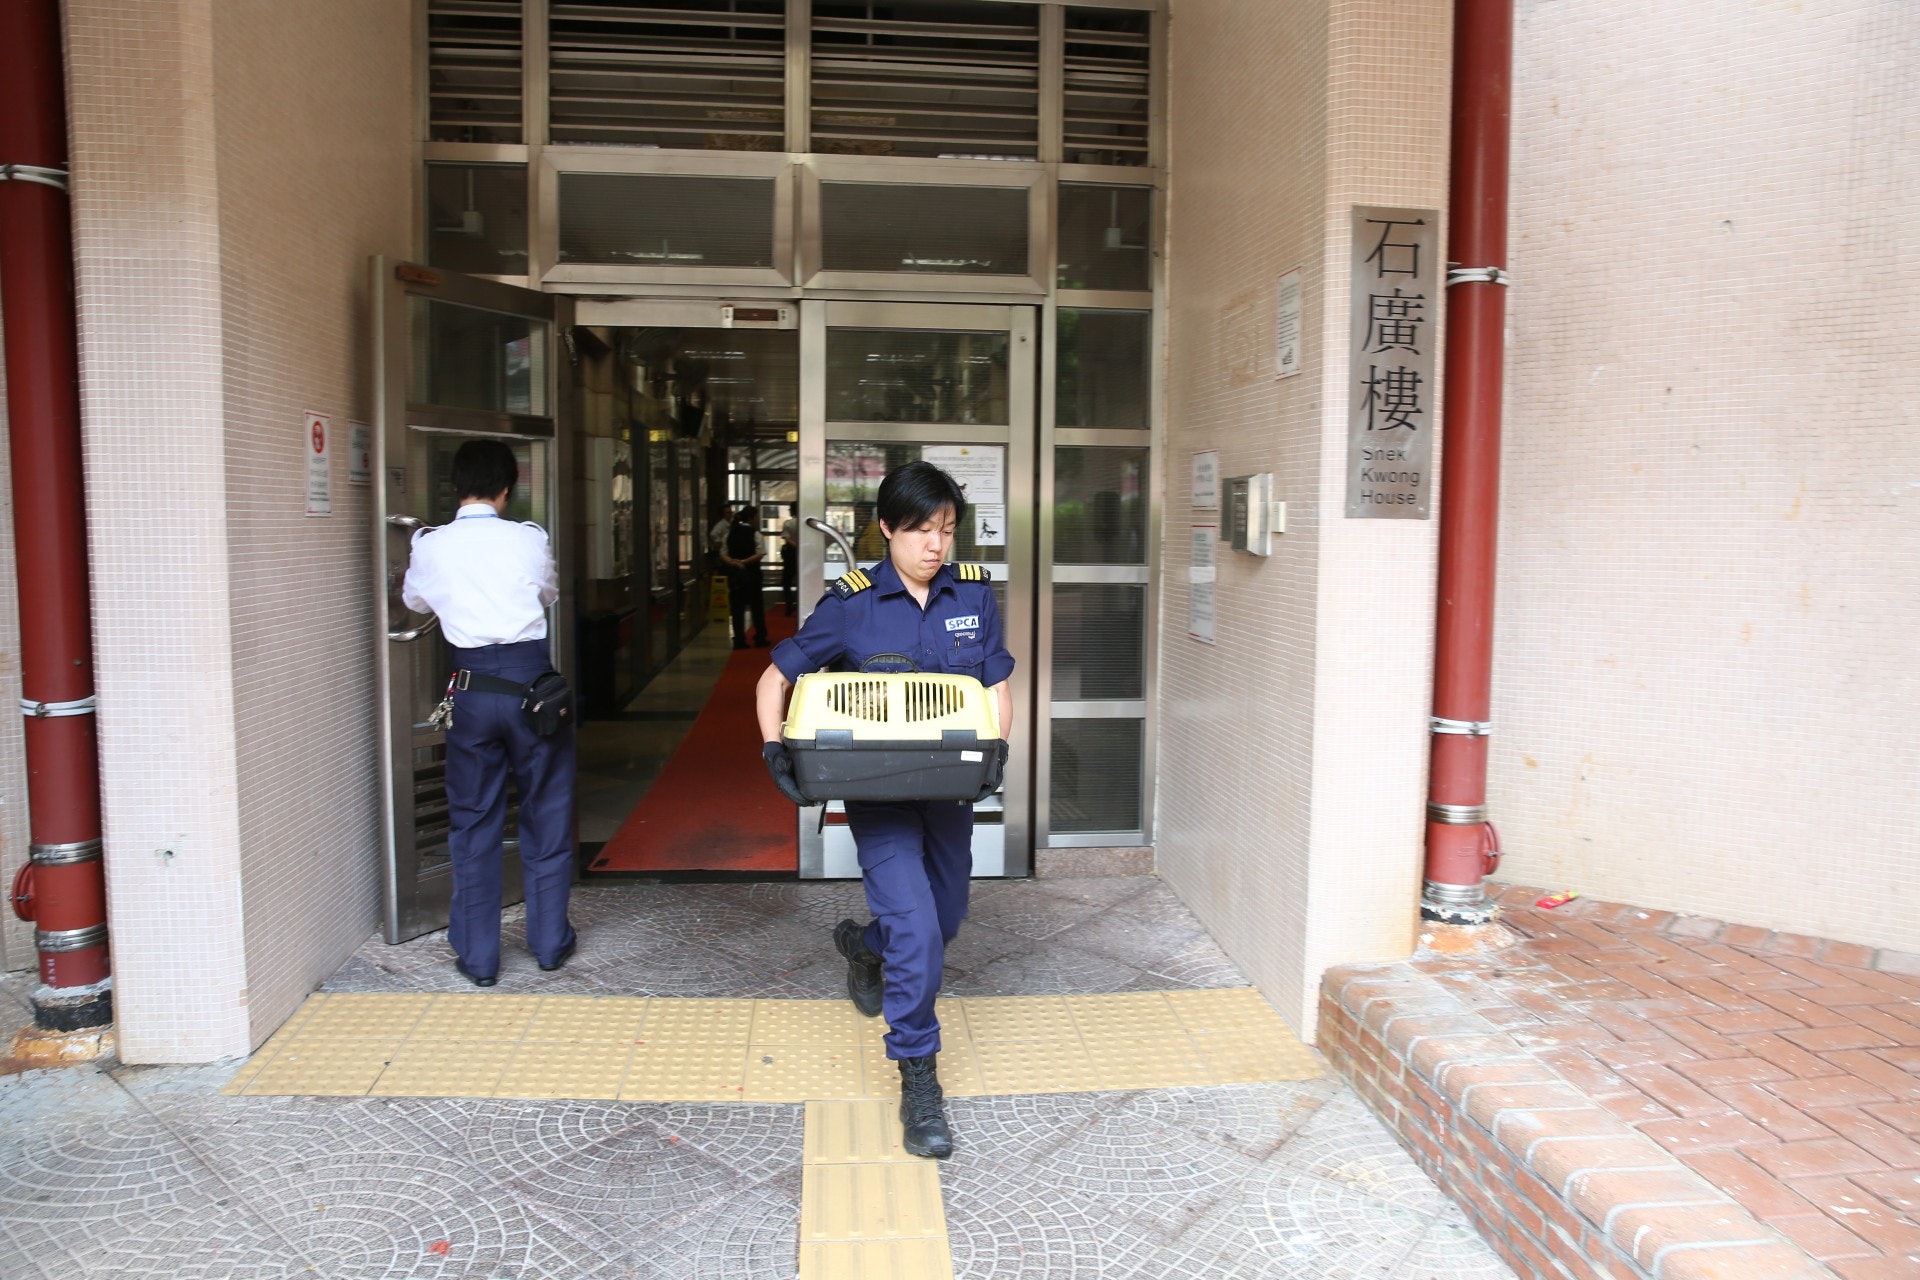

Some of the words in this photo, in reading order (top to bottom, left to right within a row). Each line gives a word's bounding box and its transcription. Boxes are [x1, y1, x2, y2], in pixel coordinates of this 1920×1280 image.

[1361, 218, 1426, 431] 石廣樓
[1361, 467, 1420, 487] Kwong
[1361, 490, 1416, 504] House
[948, 618, 977, 629] SPCA
